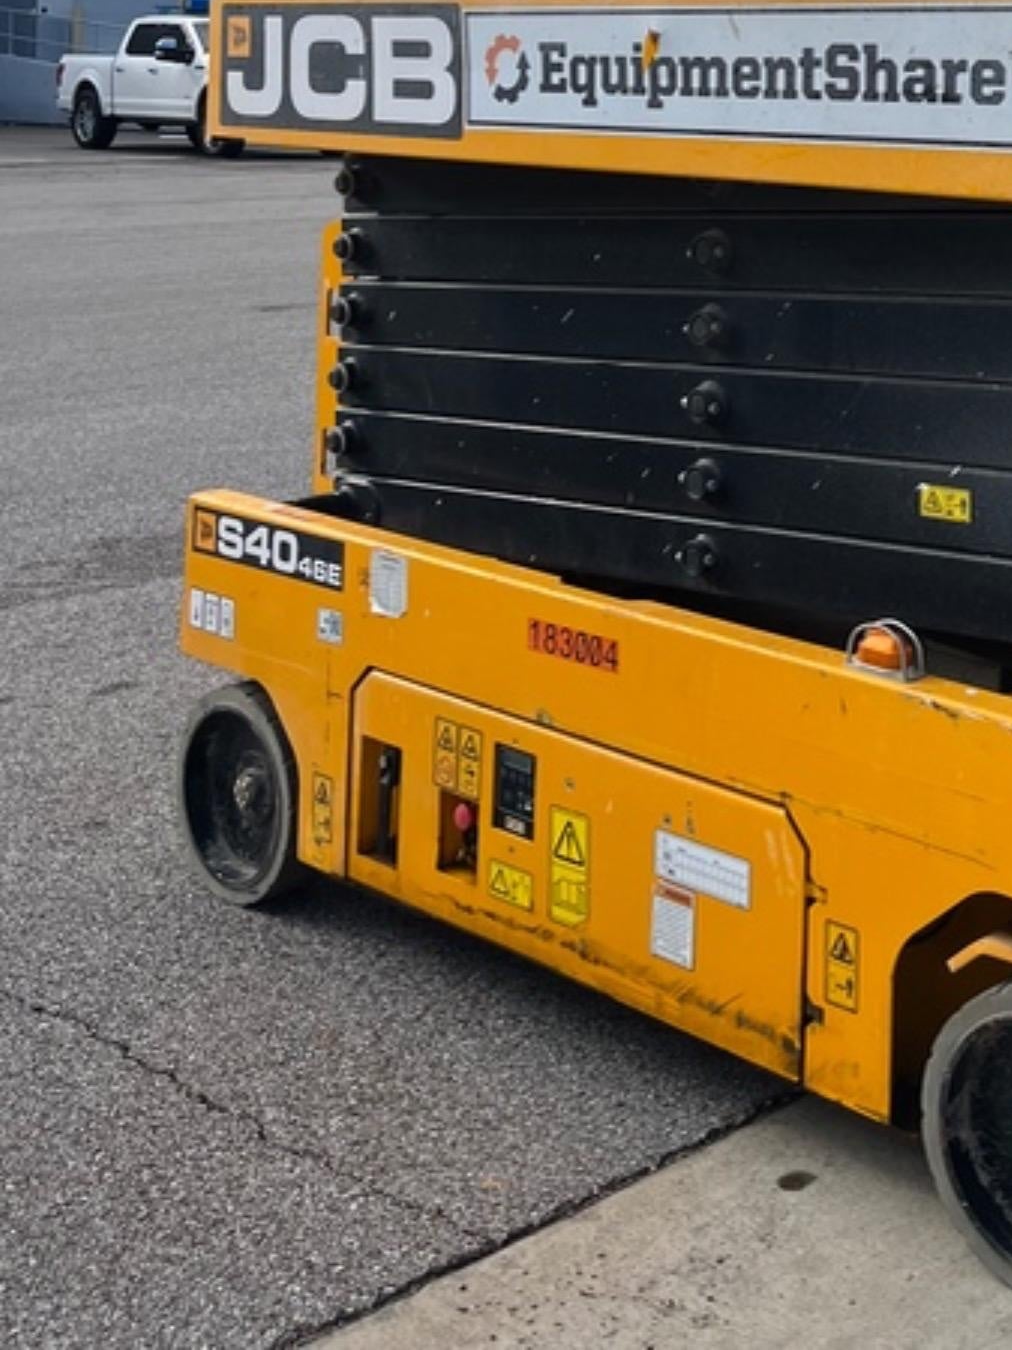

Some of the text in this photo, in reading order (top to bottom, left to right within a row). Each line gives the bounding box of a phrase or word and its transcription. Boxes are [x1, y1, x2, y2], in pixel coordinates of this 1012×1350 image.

[227, 14, 457, 125] JCB
[539, 41, 1007, 109] EquipmentShare
[529, 619, 619, 672] 183004
